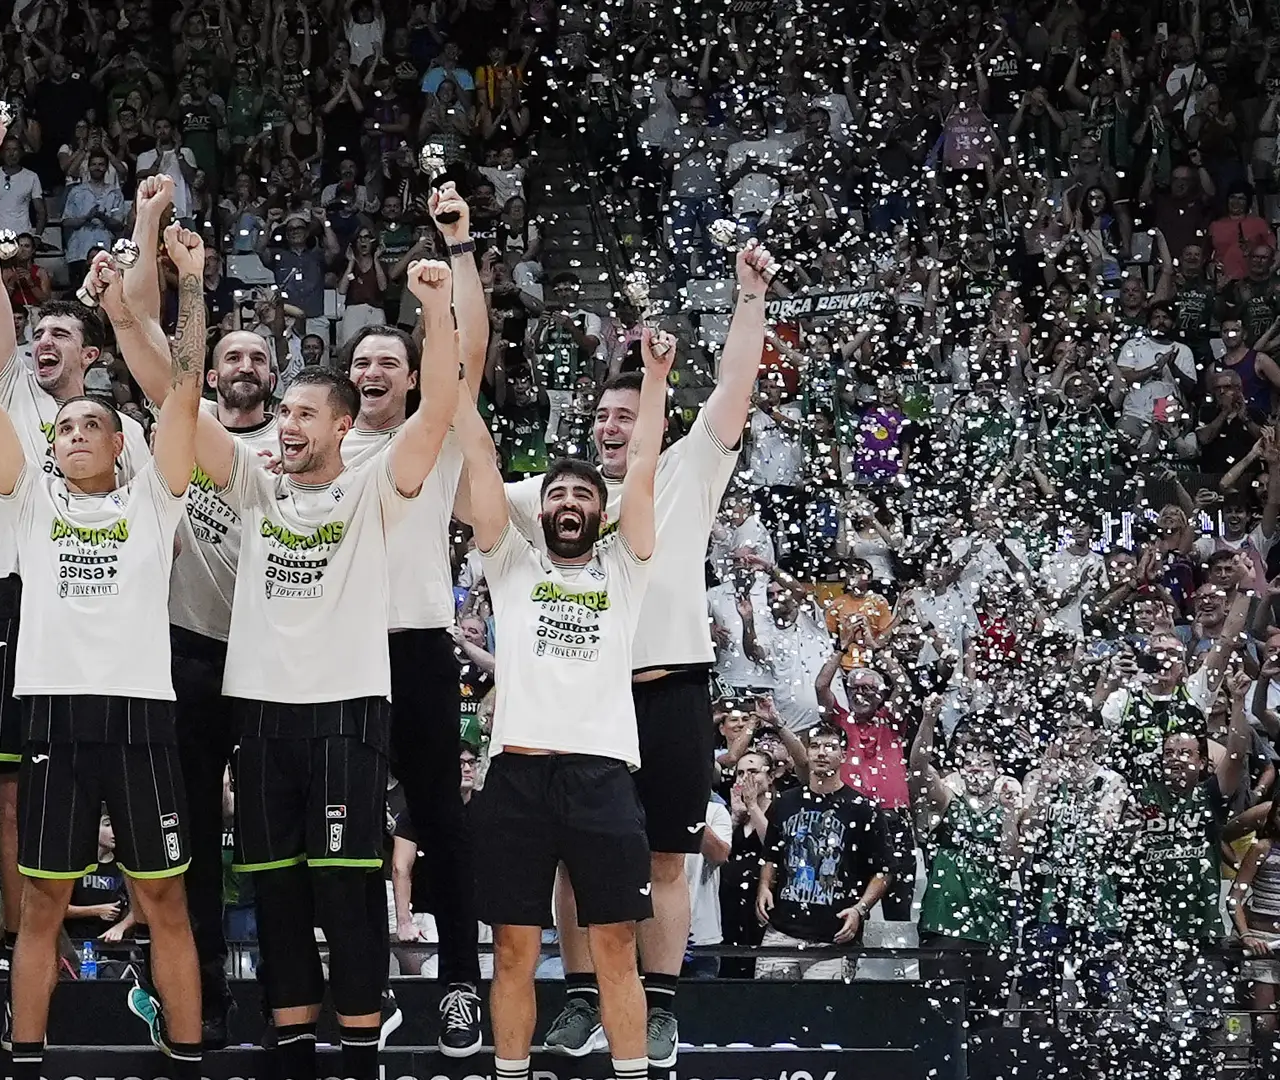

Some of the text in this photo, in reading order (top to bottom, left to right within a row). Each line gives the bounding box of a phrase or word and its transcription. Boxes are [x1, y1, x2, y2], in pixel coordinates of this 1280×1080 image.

[192, 490, 237, 525] PERCOPA
[72, 584, 112, 595] JOVENTUT
[550, 648, 595, 660] JOVENTUT
